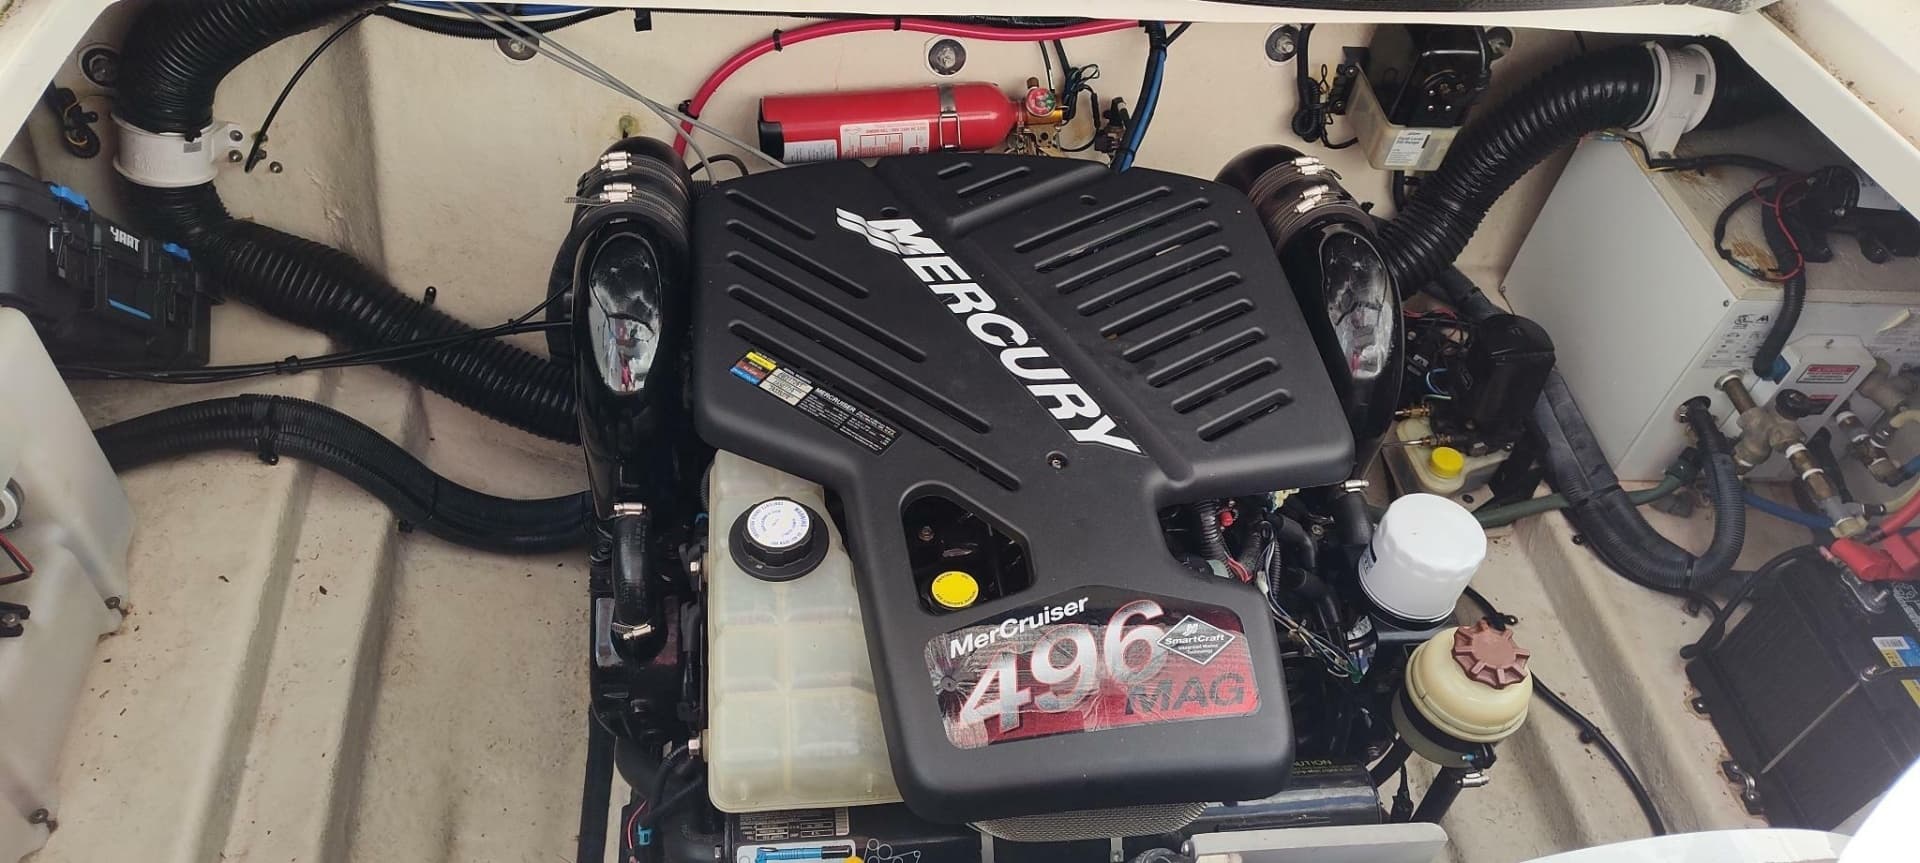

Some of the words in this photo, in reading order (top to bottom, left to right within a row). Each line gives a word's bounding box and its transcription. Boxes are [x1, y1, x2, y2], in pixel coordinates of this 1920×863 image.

[866, 218, 1143, 454] MERCURY
[949, 596, 1089, 660] MerCruiser
[1164, 634, 1224, 645] SmartCraft
[959, 599, 1168, 734] 496
[1125, 672, 1245, 716] MAG
[1294, 759, 1332, 767] AUTION
